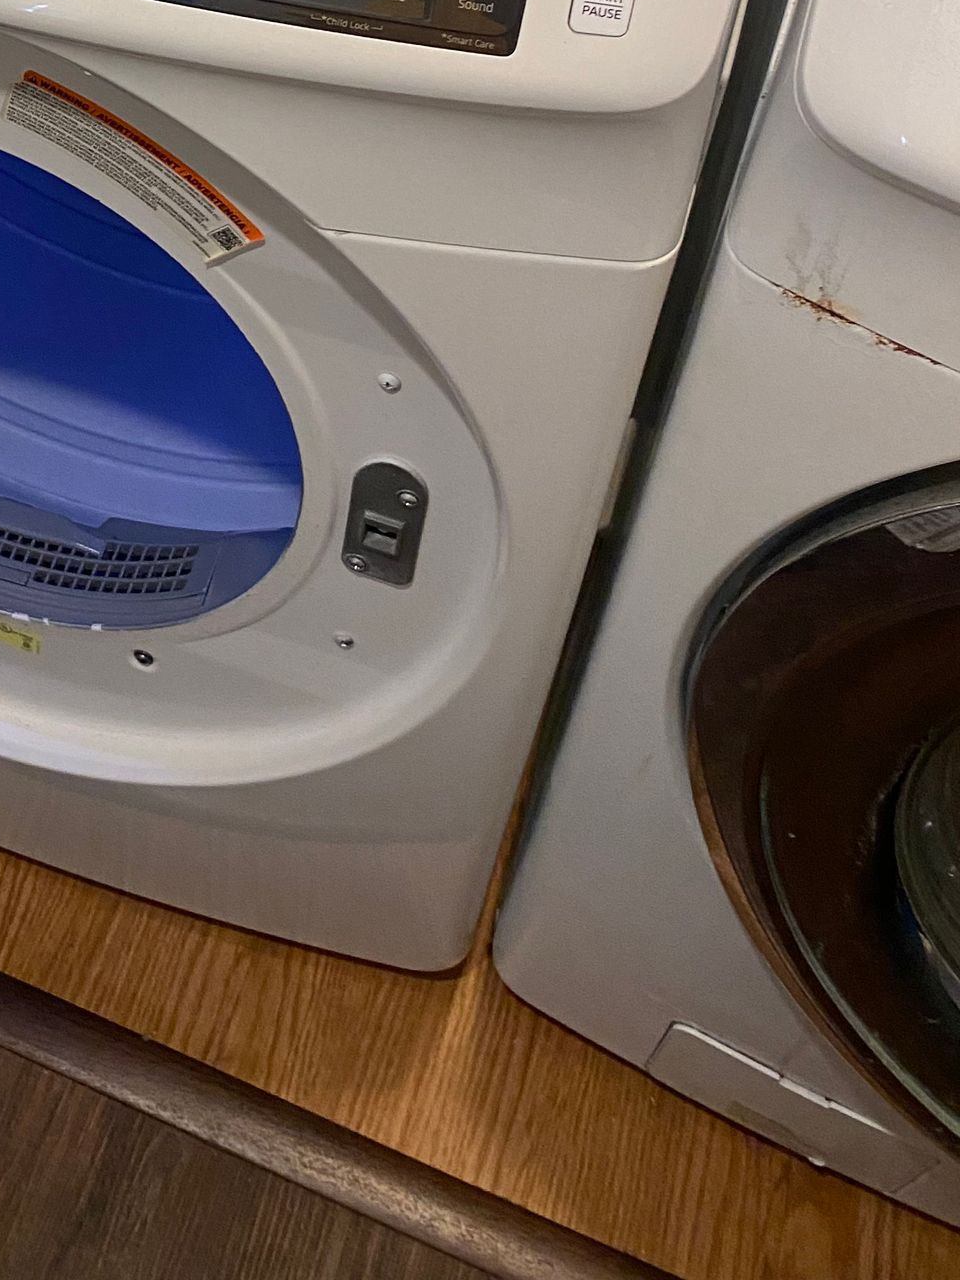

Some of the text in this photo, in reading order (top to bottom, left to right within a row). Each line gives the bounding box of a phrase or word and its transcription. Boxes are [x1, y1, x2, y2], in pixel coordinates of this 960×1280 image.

[582, 6, 622, 20] PAUSE
[350, 20, 370, 32] Lock
[475, 38, 496, 49] Care
[39, 79, 90, 112] WARNING
[96, 112, 181, 170] AVERTISSEMENT
